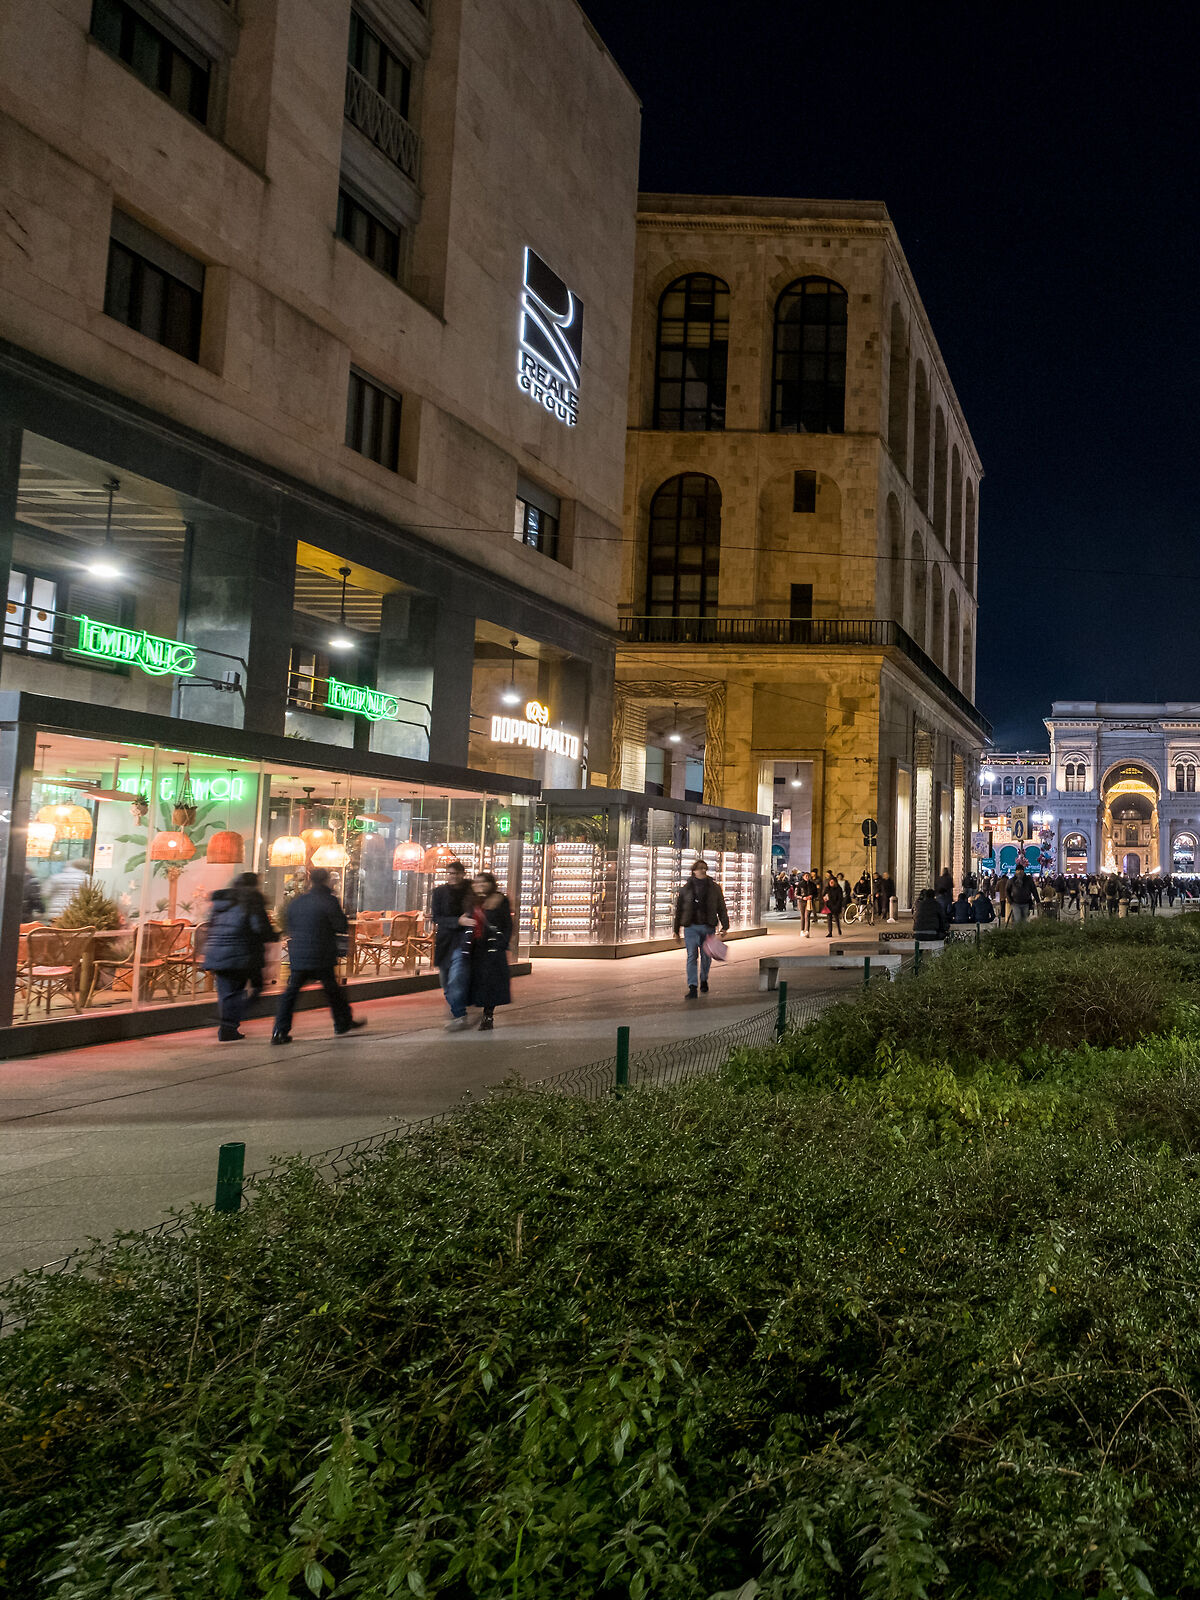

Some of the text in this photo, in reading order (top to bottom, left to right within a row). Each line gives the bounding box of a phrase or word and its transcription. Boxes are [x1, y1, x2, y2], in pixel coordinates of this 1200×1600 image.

[519, 351, 579, 414] REALE
[519, 375, 577, 425] GROUP
[73, 614, 197, 676] TEMAKINHO
[325, 676, 399, 721] TEMAKINHO
[491, 715, 580, 760] DOPPIO MALTO
